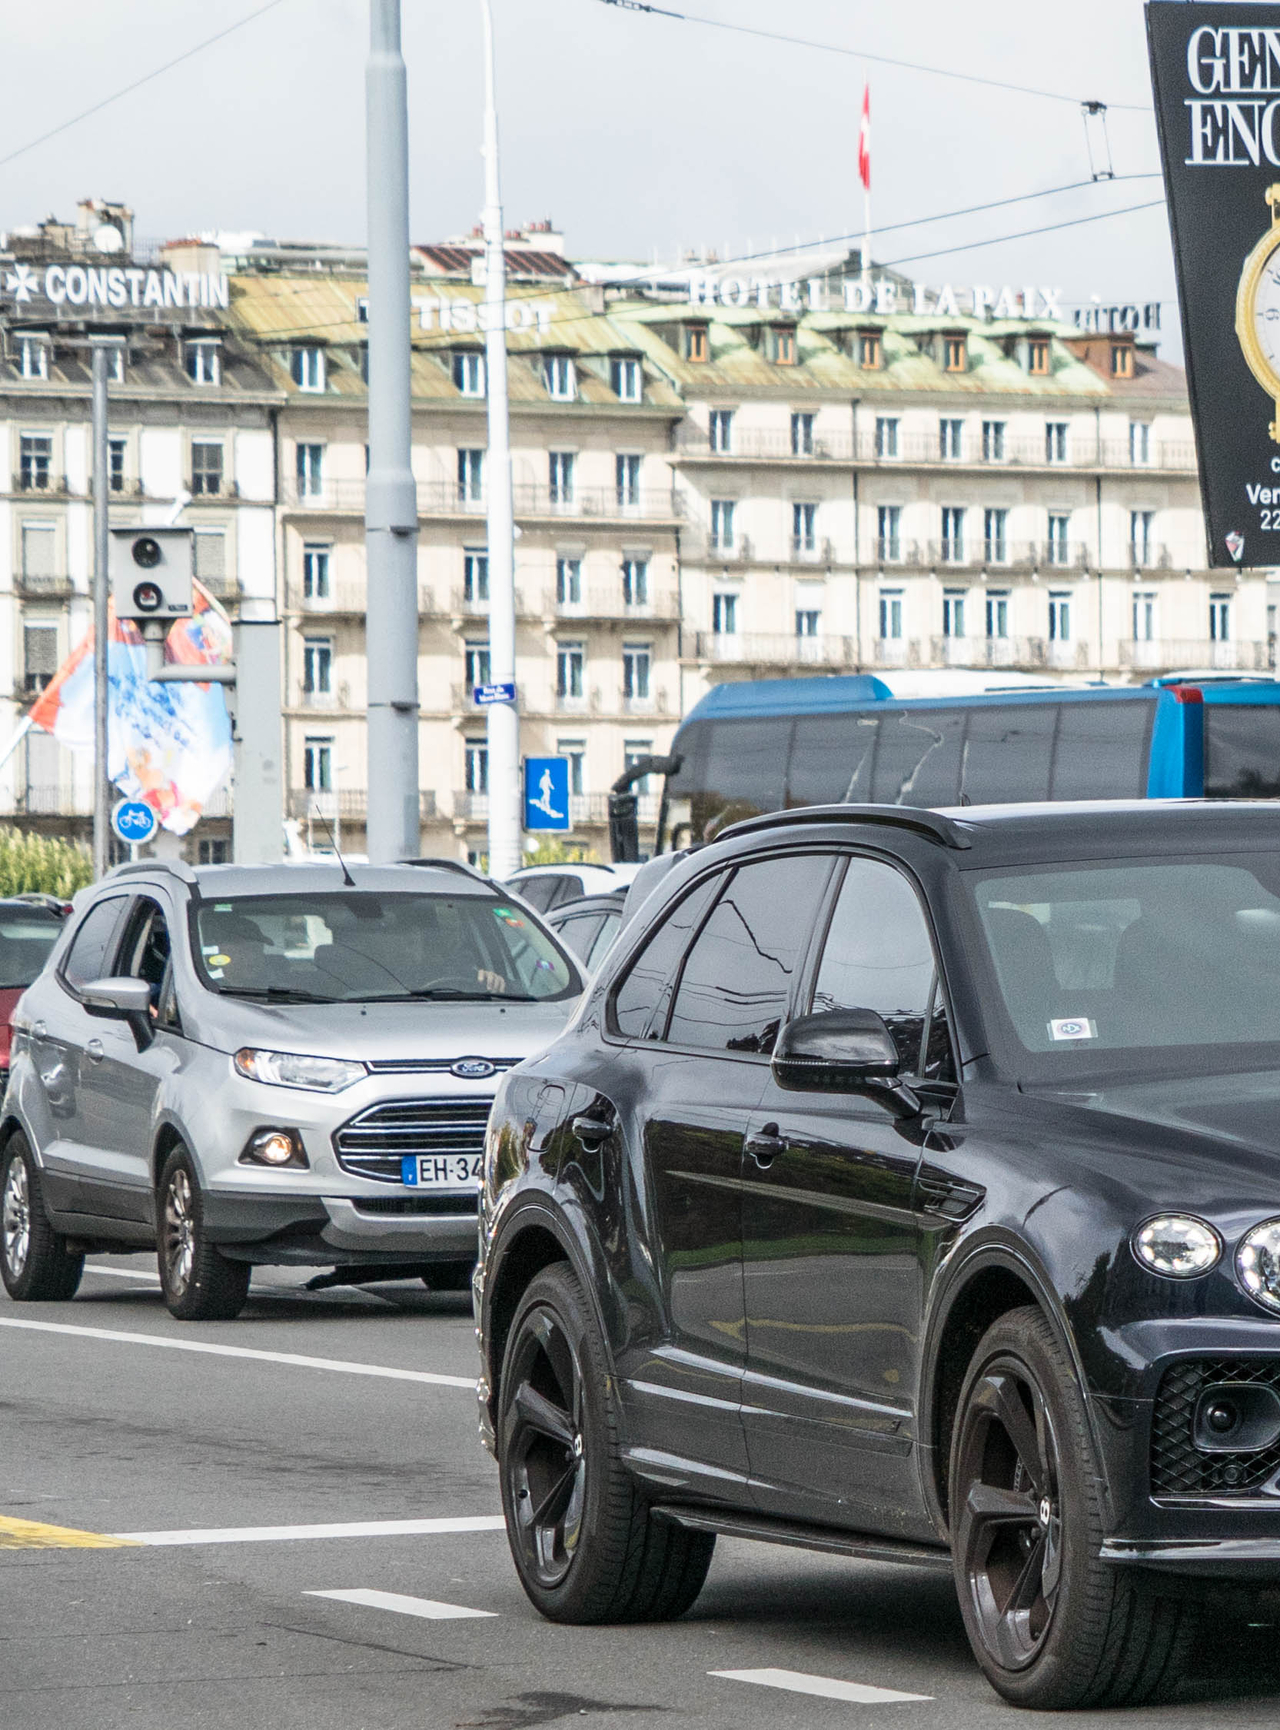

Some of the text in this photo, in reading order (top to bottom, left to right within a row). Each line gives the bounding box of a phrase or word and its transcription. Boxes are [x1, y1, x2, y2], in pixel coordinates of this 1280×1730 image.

[45, 265, 229, 308] CONSTANTIN
[688, 276, 830, 310] HOTEL
[844, 278, 897, 314] DE
[912, 283, 962, 316] LA
[972, 285, 1063, 319] PAIX
